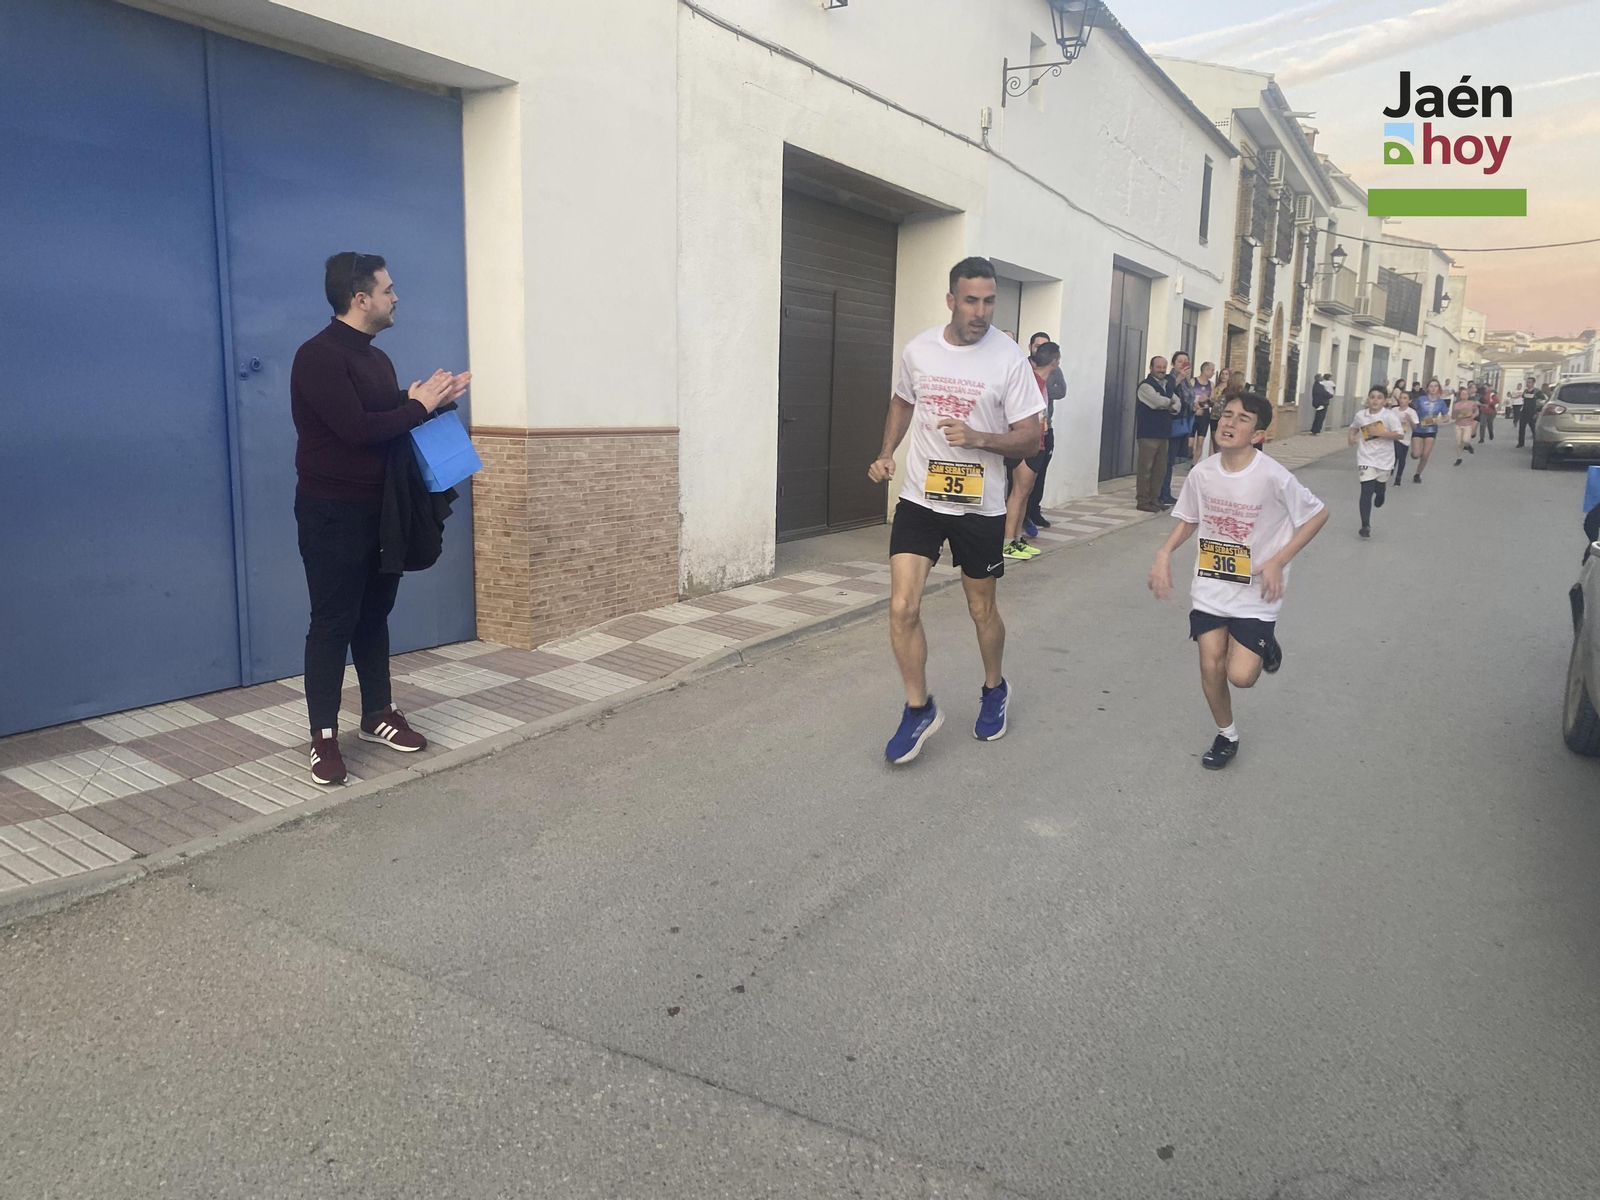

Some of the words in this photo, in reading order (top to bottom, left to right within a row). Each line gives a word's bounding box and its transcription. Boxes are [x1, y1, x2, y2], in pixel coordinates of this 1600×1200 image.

[928, 375, 956, 385] CARRERA
[957, 378, 986, 389] POPULAR
[931, 464, 945, 474] SAN
[943, 476, 965, 494] 35
[1233, 502, 1263, 511] POPULAR
[1203, 542, 1215, 552] SAN
[1212, 554, 1236, 573] 316
